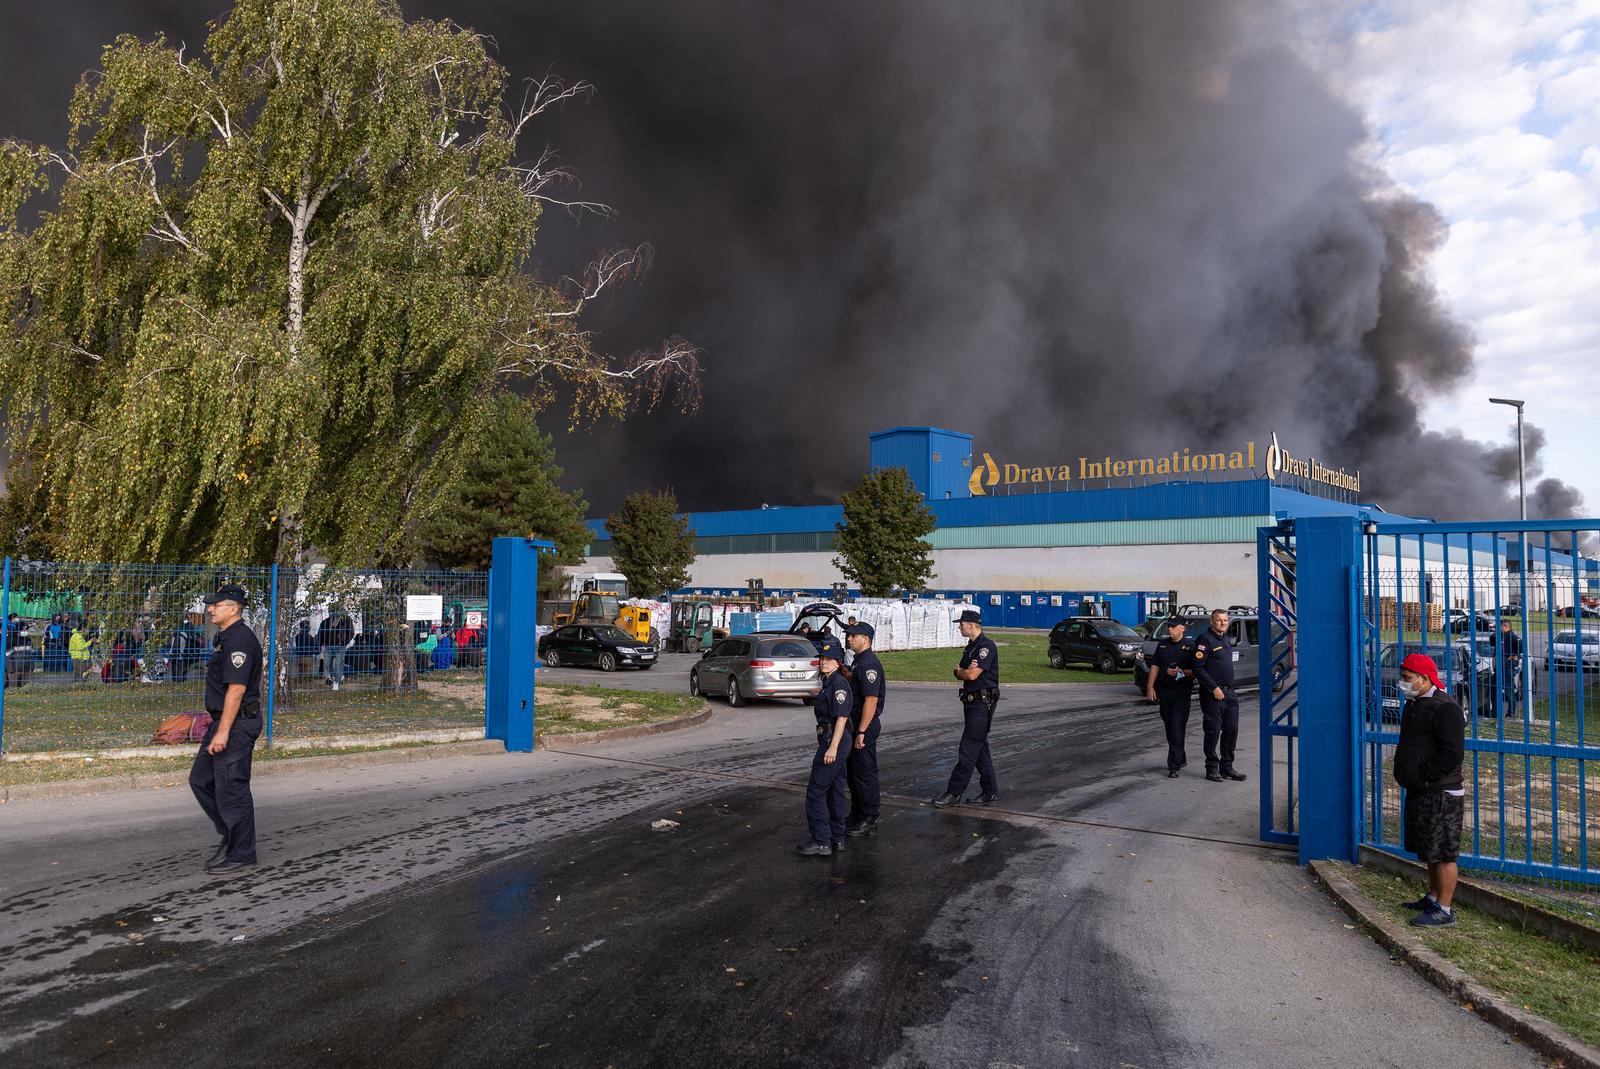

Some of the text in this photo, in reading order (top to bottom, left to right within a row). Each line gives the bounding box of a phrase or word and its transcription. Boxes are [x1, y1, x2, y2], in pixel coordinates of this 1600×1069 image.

[1003, 441, 1256, 484] Drava International
[1281, 448, 1360, 492] Drava International
